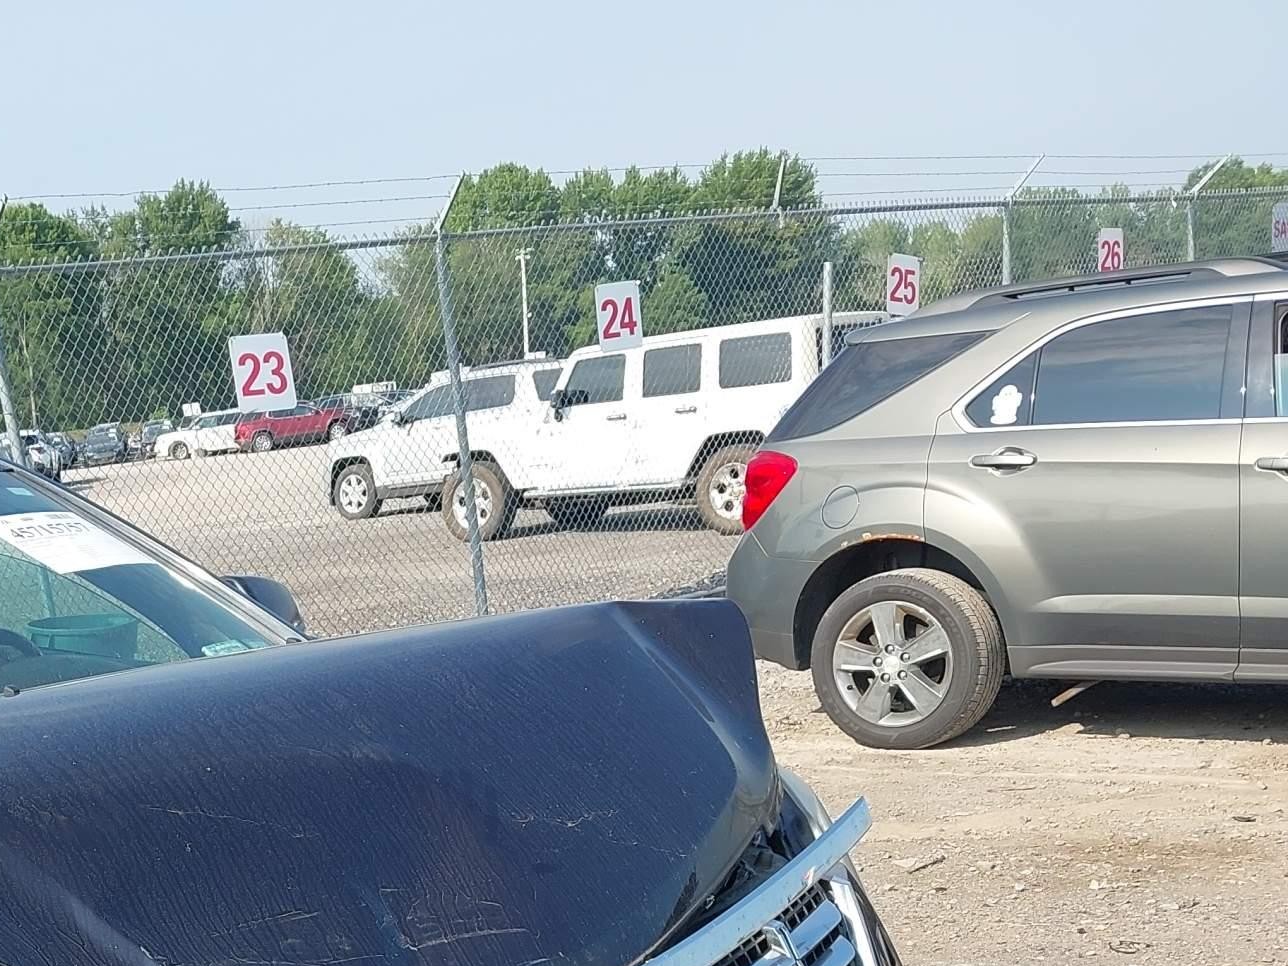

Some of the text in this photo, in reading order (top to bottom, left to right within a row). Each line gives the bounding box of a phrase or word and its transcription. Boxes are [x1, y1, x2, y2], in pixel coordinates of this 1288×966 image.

[1273, 220, 1288, 239] SA
[1101, 240, 1121, 271] 26
[890, 267, 917, 304] 25
[601, 298, 638, 339] 24
[238, 351, 289, 397] 23
[10, 521, 91, 539] 45715757
